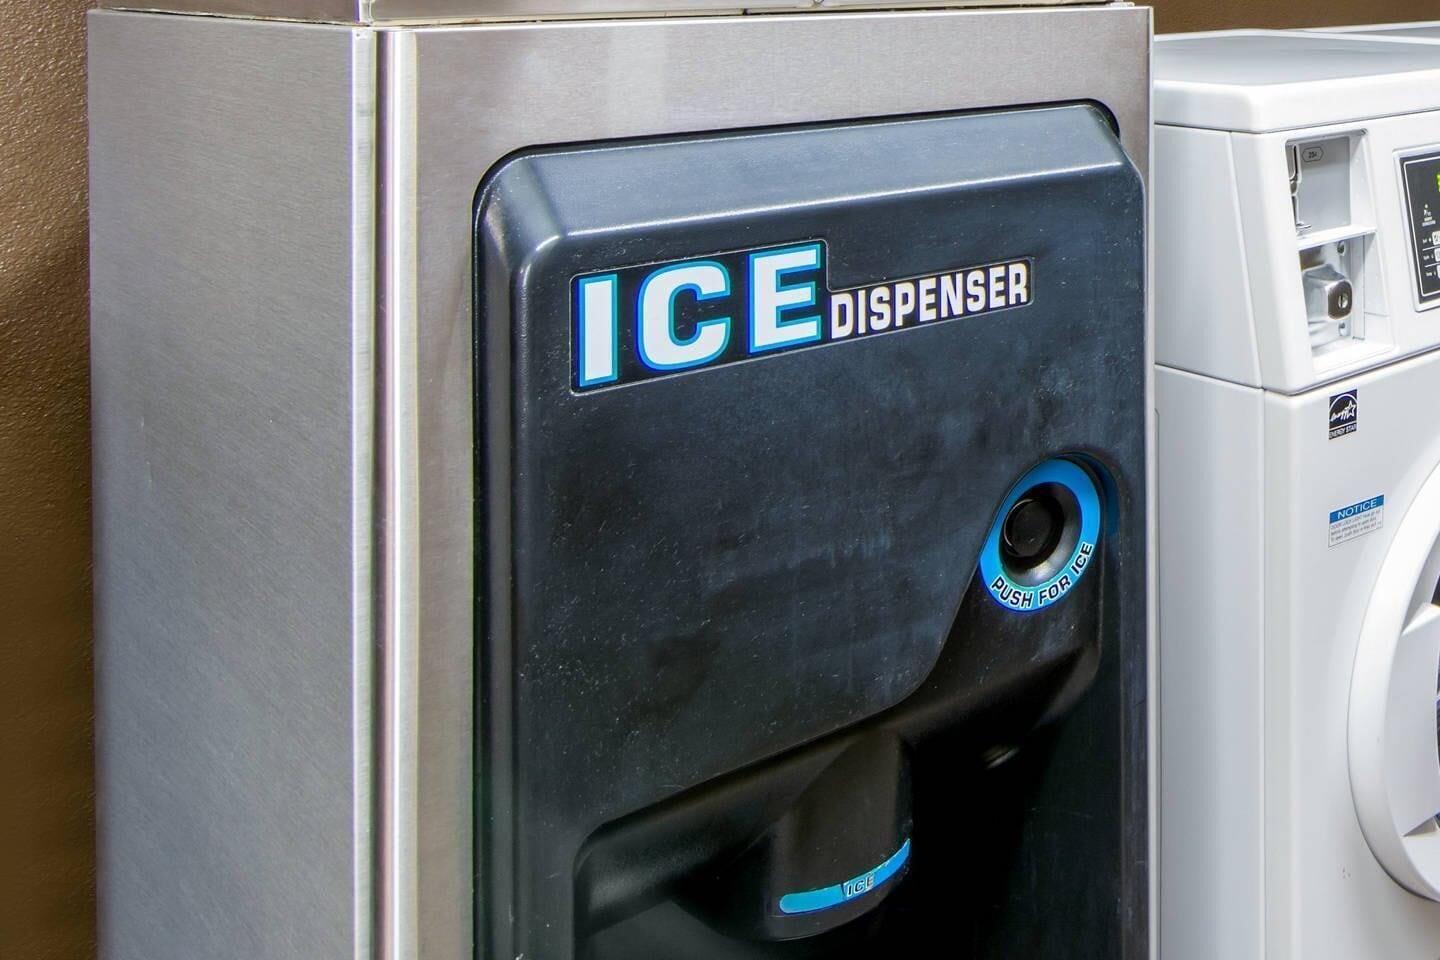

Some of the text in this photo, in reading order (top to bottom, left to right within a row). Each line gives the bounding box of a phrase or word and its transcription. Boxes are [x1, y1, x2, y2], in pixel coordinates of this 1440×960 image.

[577, 243, 1029, 387] ICE DISPENSER
[1338, 499, 1377, 519] NOTICE
[991, 543, 1093, 608] PUSH FOR ICE
[846, 874, 875, 898] ICE
